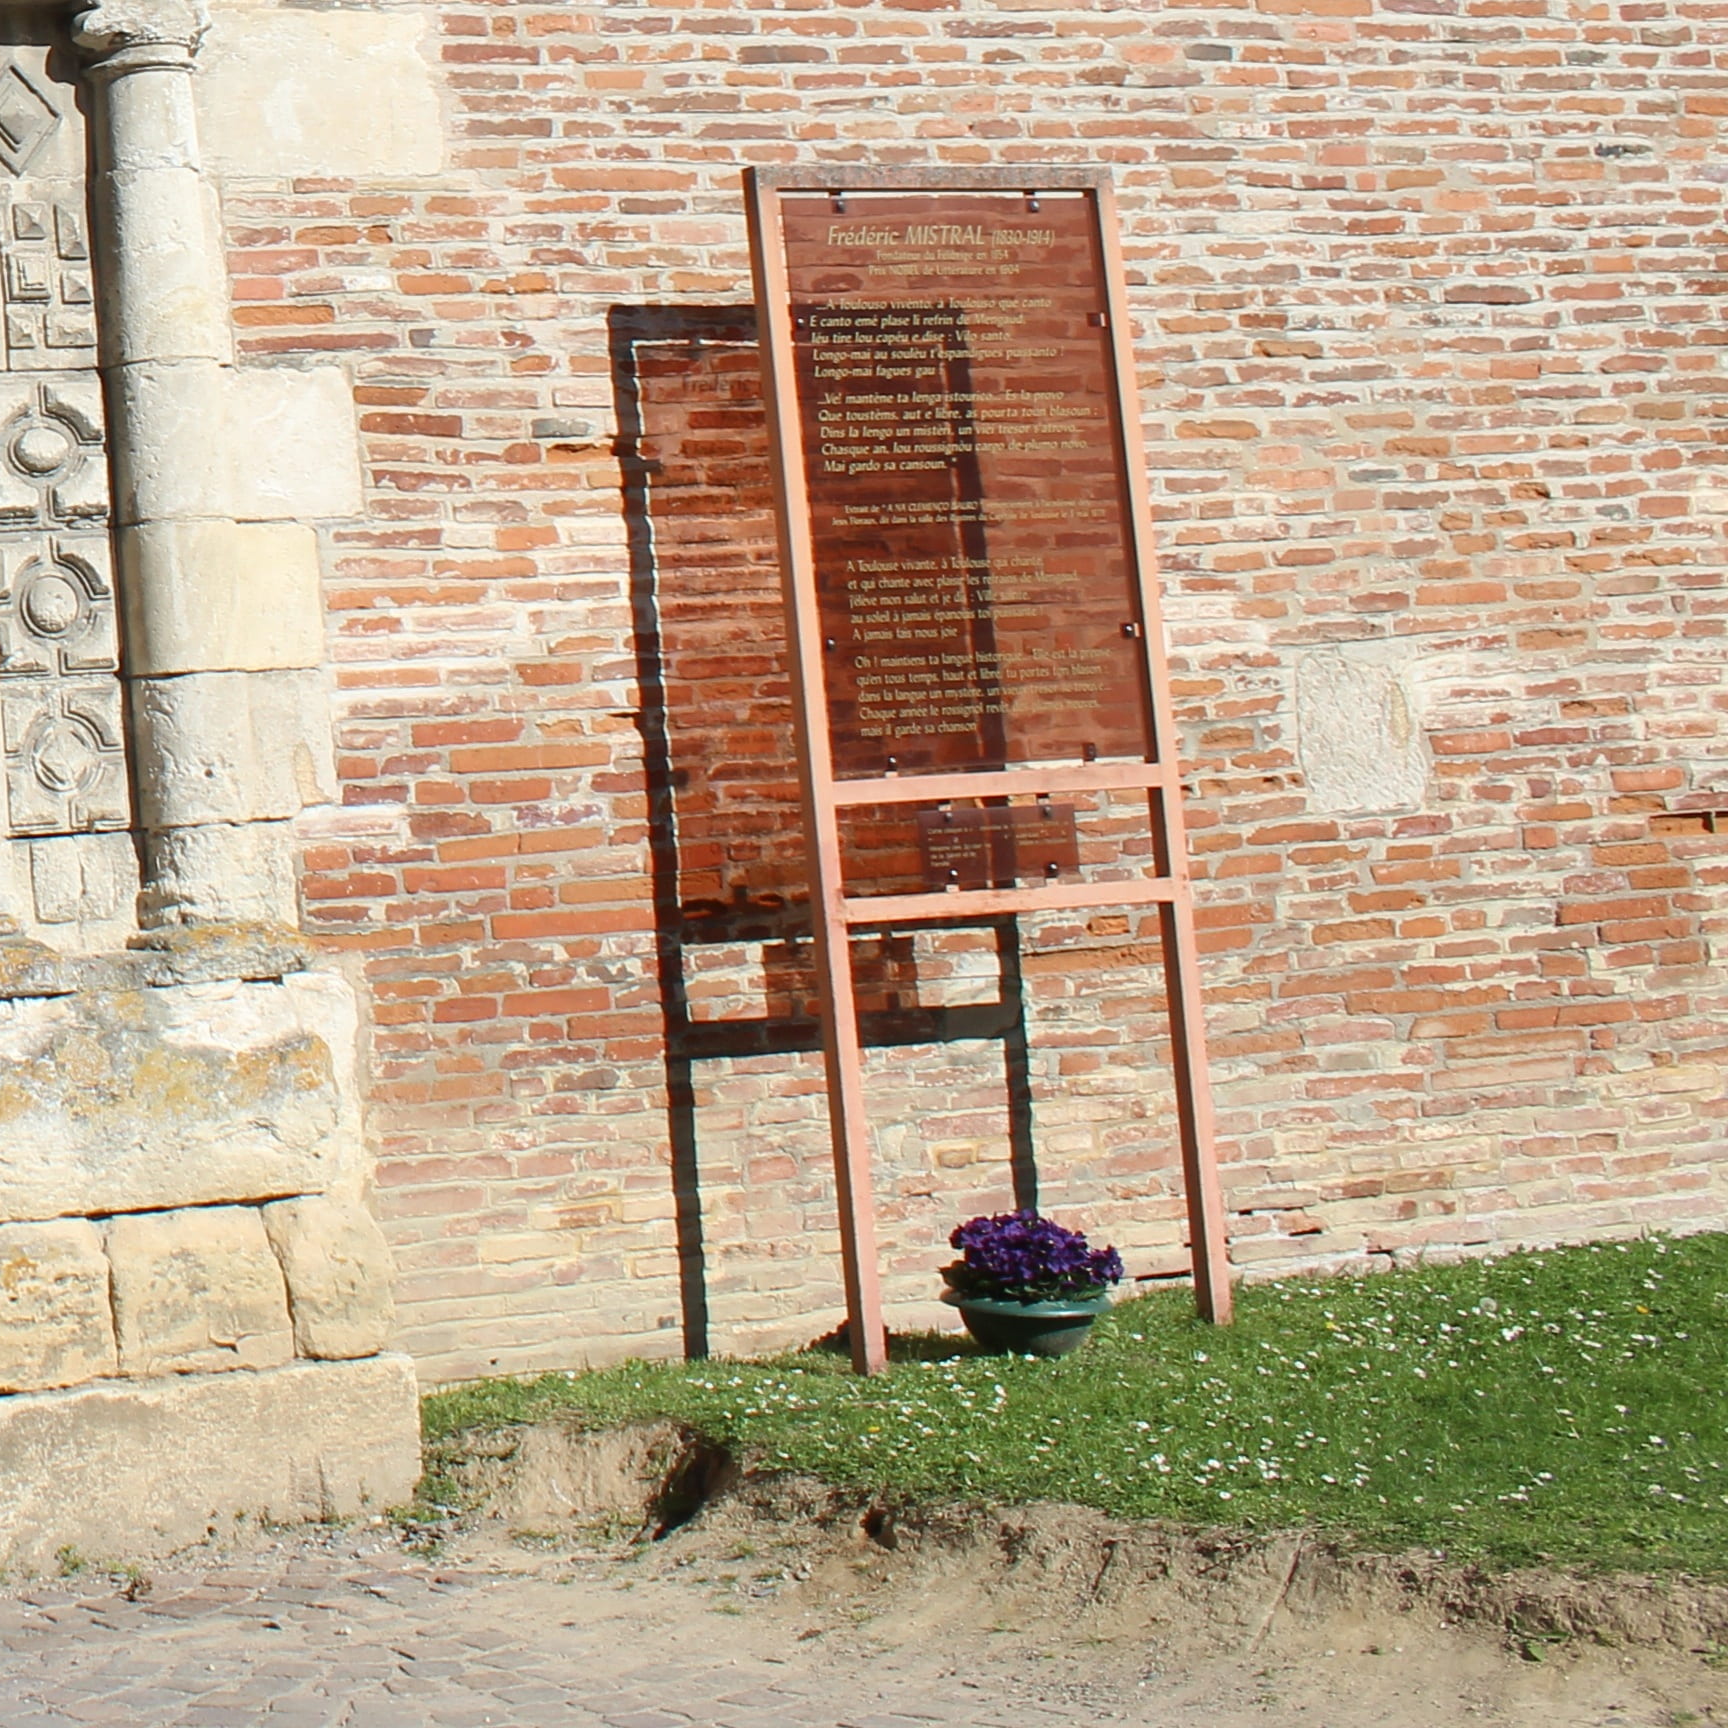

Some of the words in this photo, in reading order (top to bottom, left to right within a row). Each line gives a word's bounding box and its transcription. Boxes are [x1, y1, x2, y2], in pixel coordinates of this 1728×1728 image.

[828, 225, 900, 245] Frédéric
[905, 225, 985, 245] MISTRAL
[991, 229, 1056, 248] (1830-1914)
[840, 298, 887, 310] Toulouso
[949, 298, 995, 308] Toulouso
[1022, 298, 1051, 308] canto
[820, 315, 852, 327] canto
[833, 333, 852, 343] tire
[855, 332, 873, 343] lou
[813, 348, 871, 363] Longo-mai
[874, 350, 888, 359] au
[815, 366, 873, 380] Longo-mai
[897, 393, 908, 403] ta
[818, 410, 843, 421] Que
[903, 409, 921, 420] aut
[820, 426, 845, 438] Dins
[849, 426, 859, 438] la
[896, 428, 910, 437] un
[822, 442, 869, 457] Chasque
[893, 442, 910, 453] lou
[824, 460, 845, 472] Mai
[848, 460, 879, 474] gardo
[884, 461, 896, 471] sa
[857, 559, 898, 572] Toulouse
[847, 579, 857, 590] et
[878, 577, 911, 589] chante
[913, 577, 934, 587] avec
[880, 595, 902, 605] mon
[859, 705, 897, 722] Chaque
